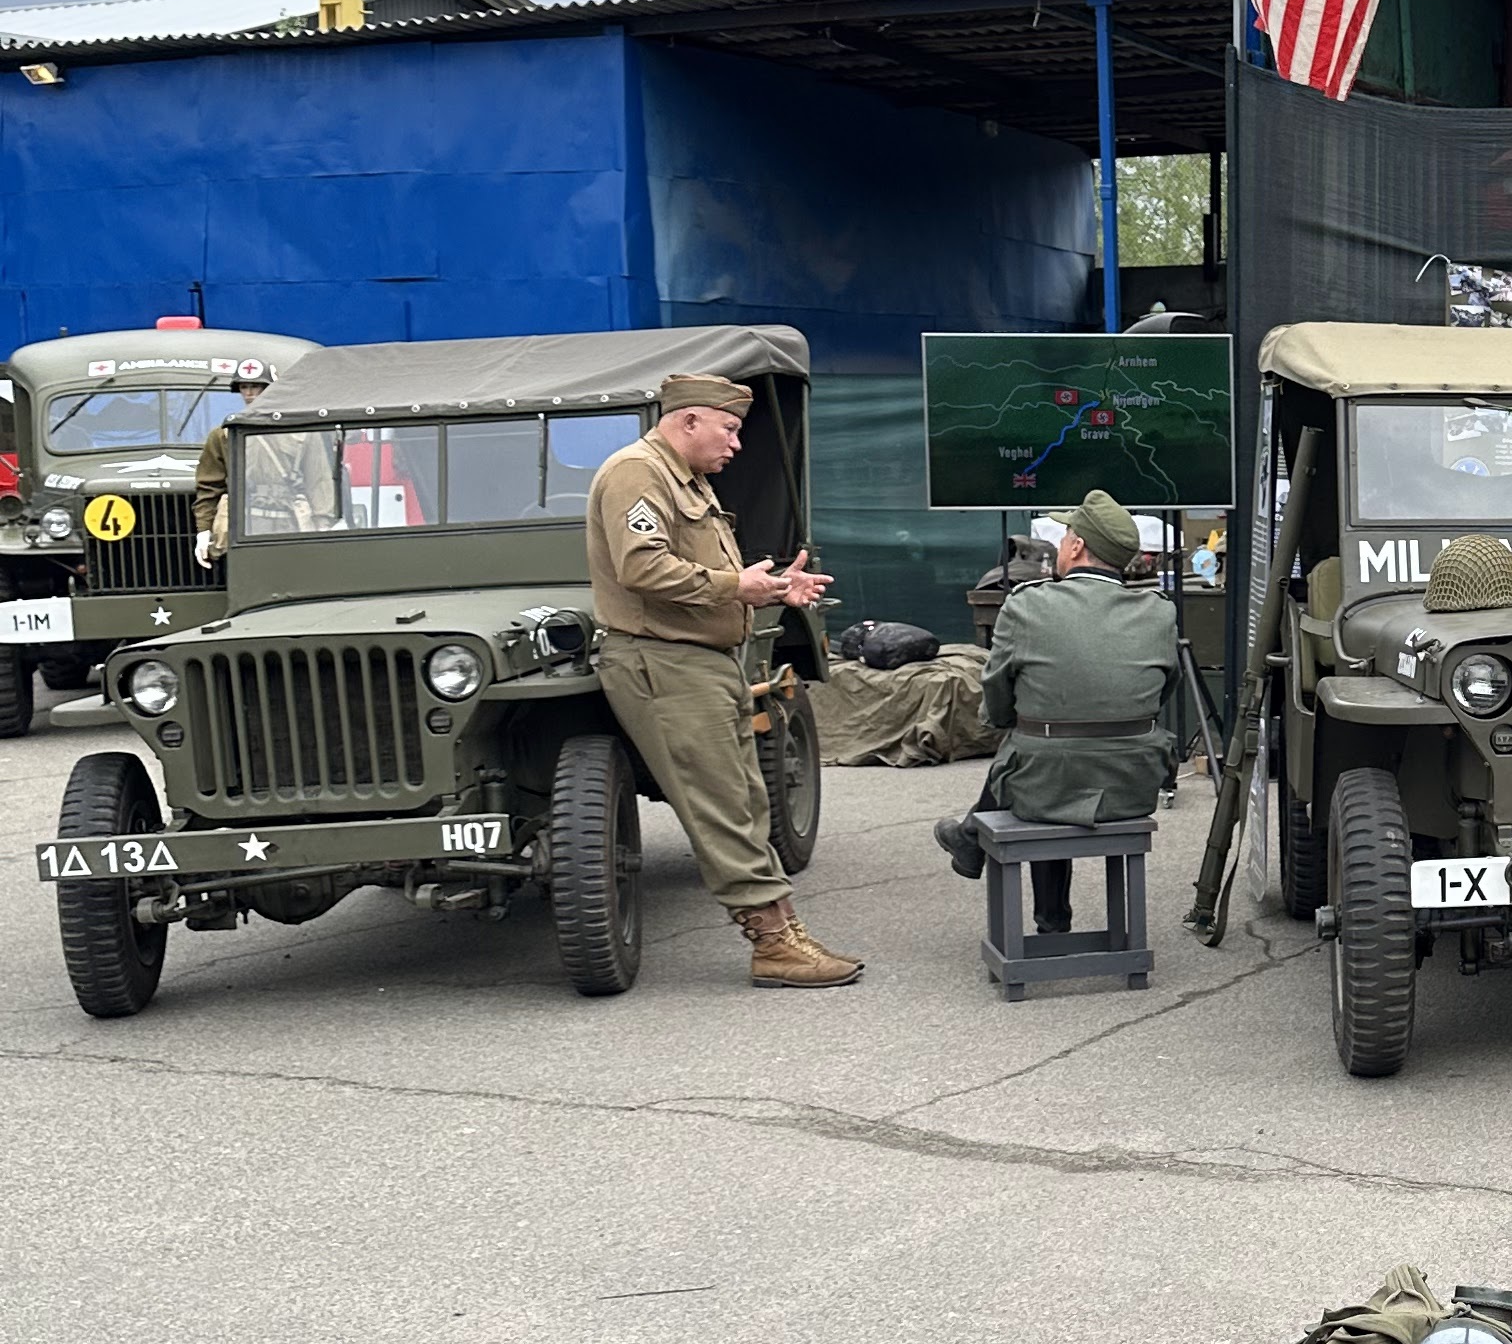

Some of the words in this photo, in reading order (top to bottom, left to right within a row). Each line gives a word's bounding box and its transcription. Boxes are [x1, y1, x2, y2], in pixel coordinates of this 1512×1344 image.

[1118, 356, 1158, 368] Arnhem
[1080, 427, 1110, 440] Grave
[998, 446, 1034, 460] Veghel
[100, 500, 122, 537] 4
[441, 822, 502, 854] HQ7
[1438, 866, 1488, 902] 1-X
